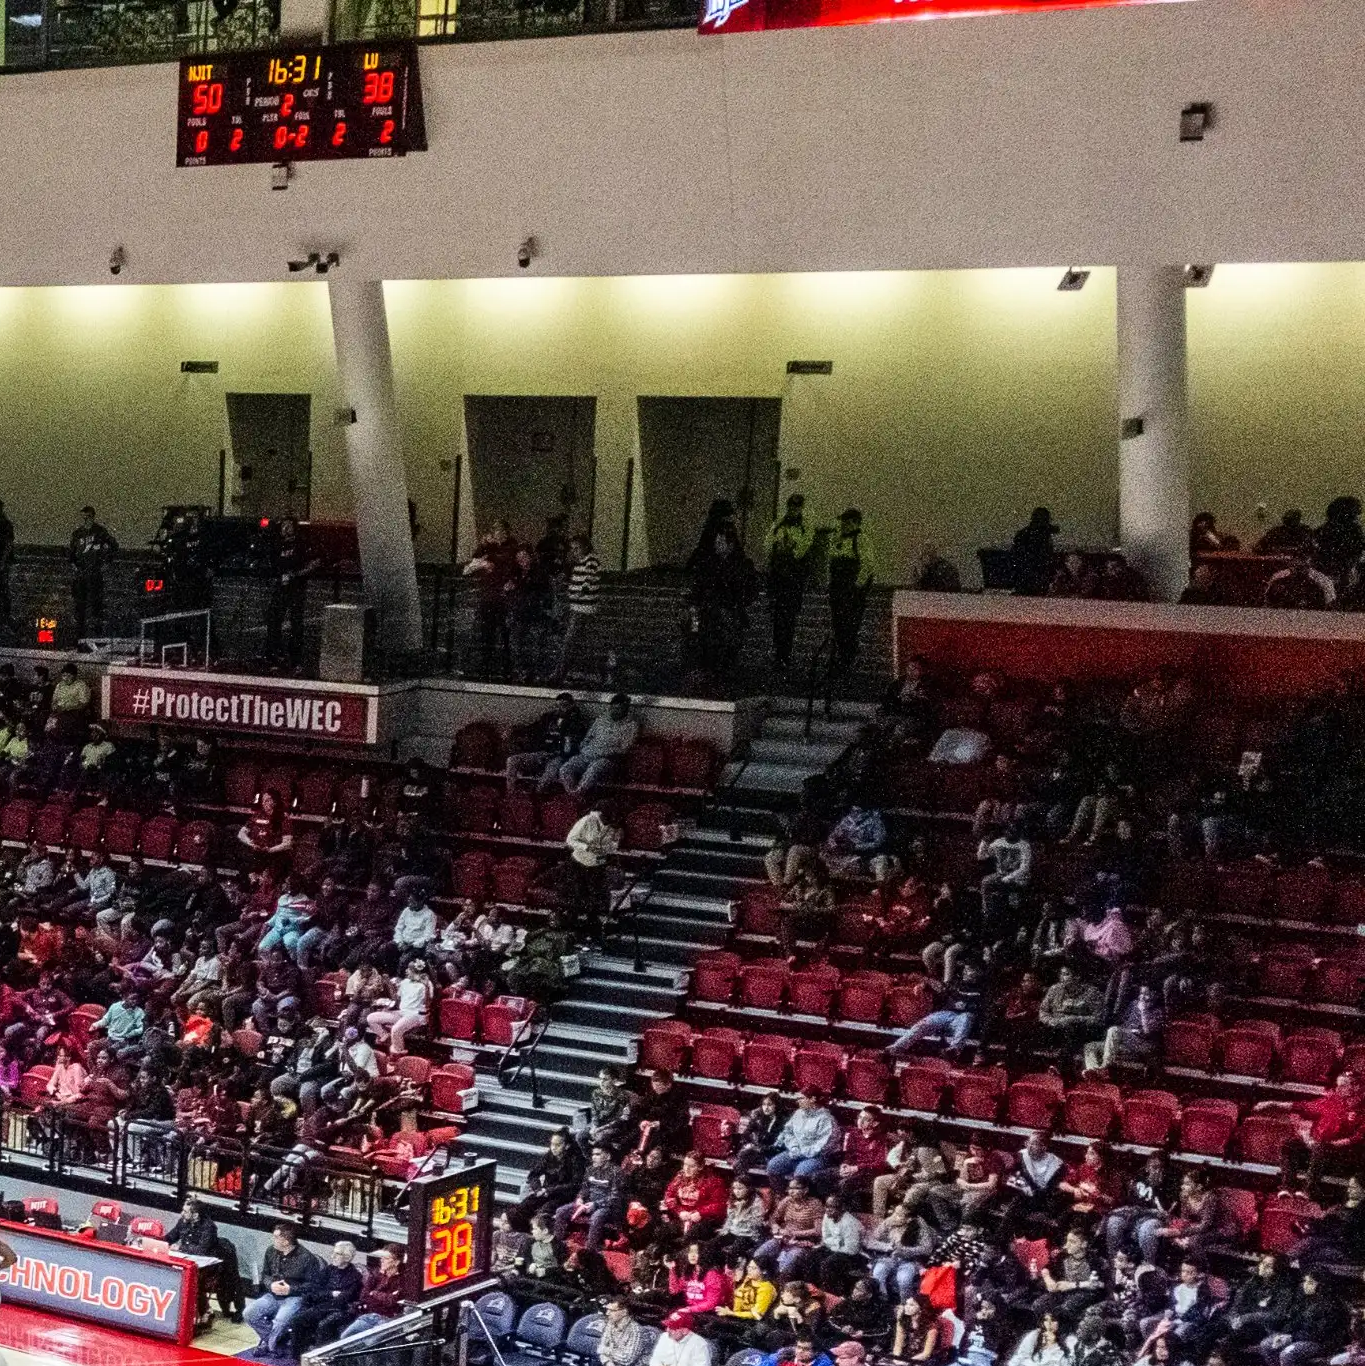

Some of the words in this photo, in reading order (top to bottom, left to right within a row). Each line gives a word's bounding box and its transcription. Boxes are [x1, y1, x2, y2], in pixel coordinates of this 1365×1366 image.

[187, 64, 214, 82] NJIT
[268, 54, 322, 84] 16:31
[363, 52, 379, 69] LU
[192, 82, 224, 115] 50
[362, 72, 394, 104] 38
[281, 94, 294, 117] 2
[195, 130, 208, 154] 0
[229, 128, 244, 152] 2
[332, 121, 347, 146] 2
[379, 119, 395, 144] 2
[131, 686, 343, 733] #ProtectTheWEC
[432, 1185, 481, 1226] 16:31
[429, 1222, 474, 1286] 28
